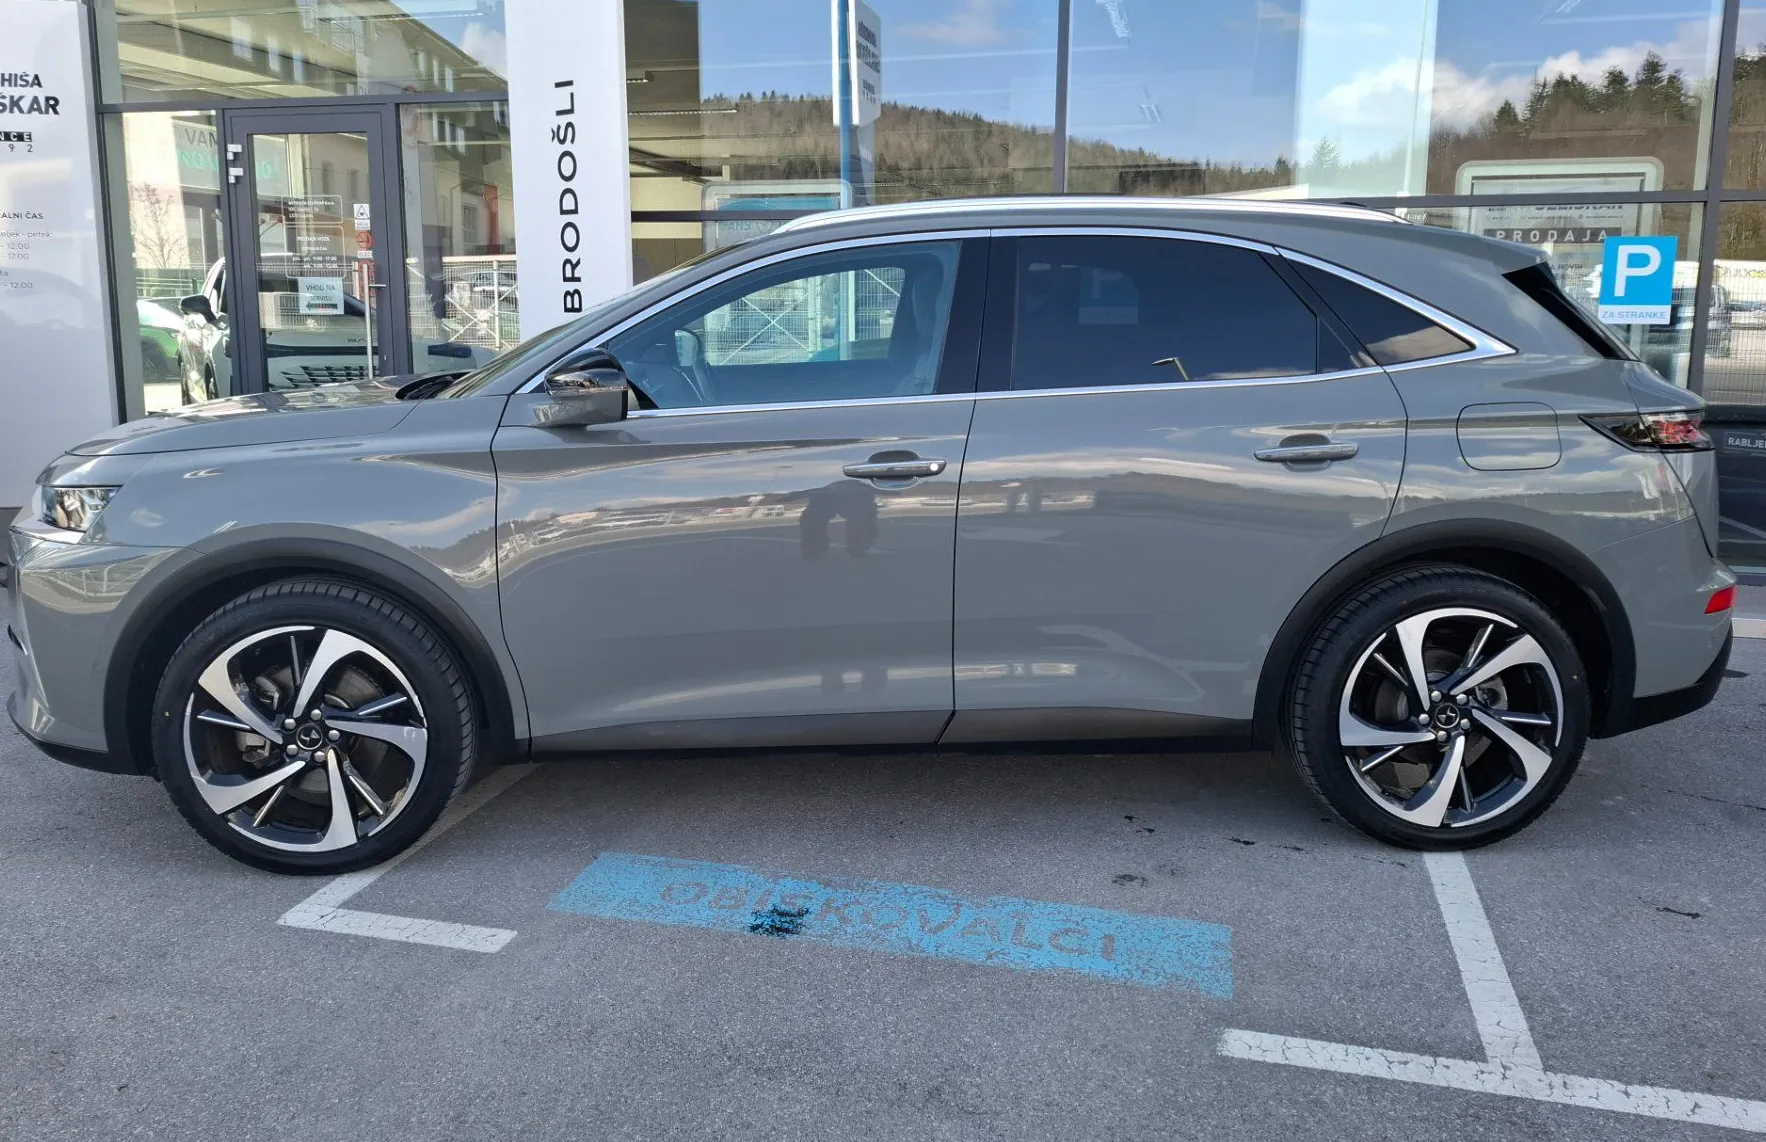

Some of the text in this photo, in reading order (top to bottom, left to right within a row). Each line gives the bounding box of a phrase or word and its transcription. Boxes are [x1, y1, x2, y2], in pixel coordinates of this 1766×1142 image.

[1, 72, 42, 88] HIŠA
[0, 93, 60, 115] ŠKAR
[551, 80, 583, 313] BRODOŠLI
[1496, 229, 1608, 242] PRODAJA
[1614, 244, 1662, 297] P
[1617, 311, 1666, 319] STRANKE
